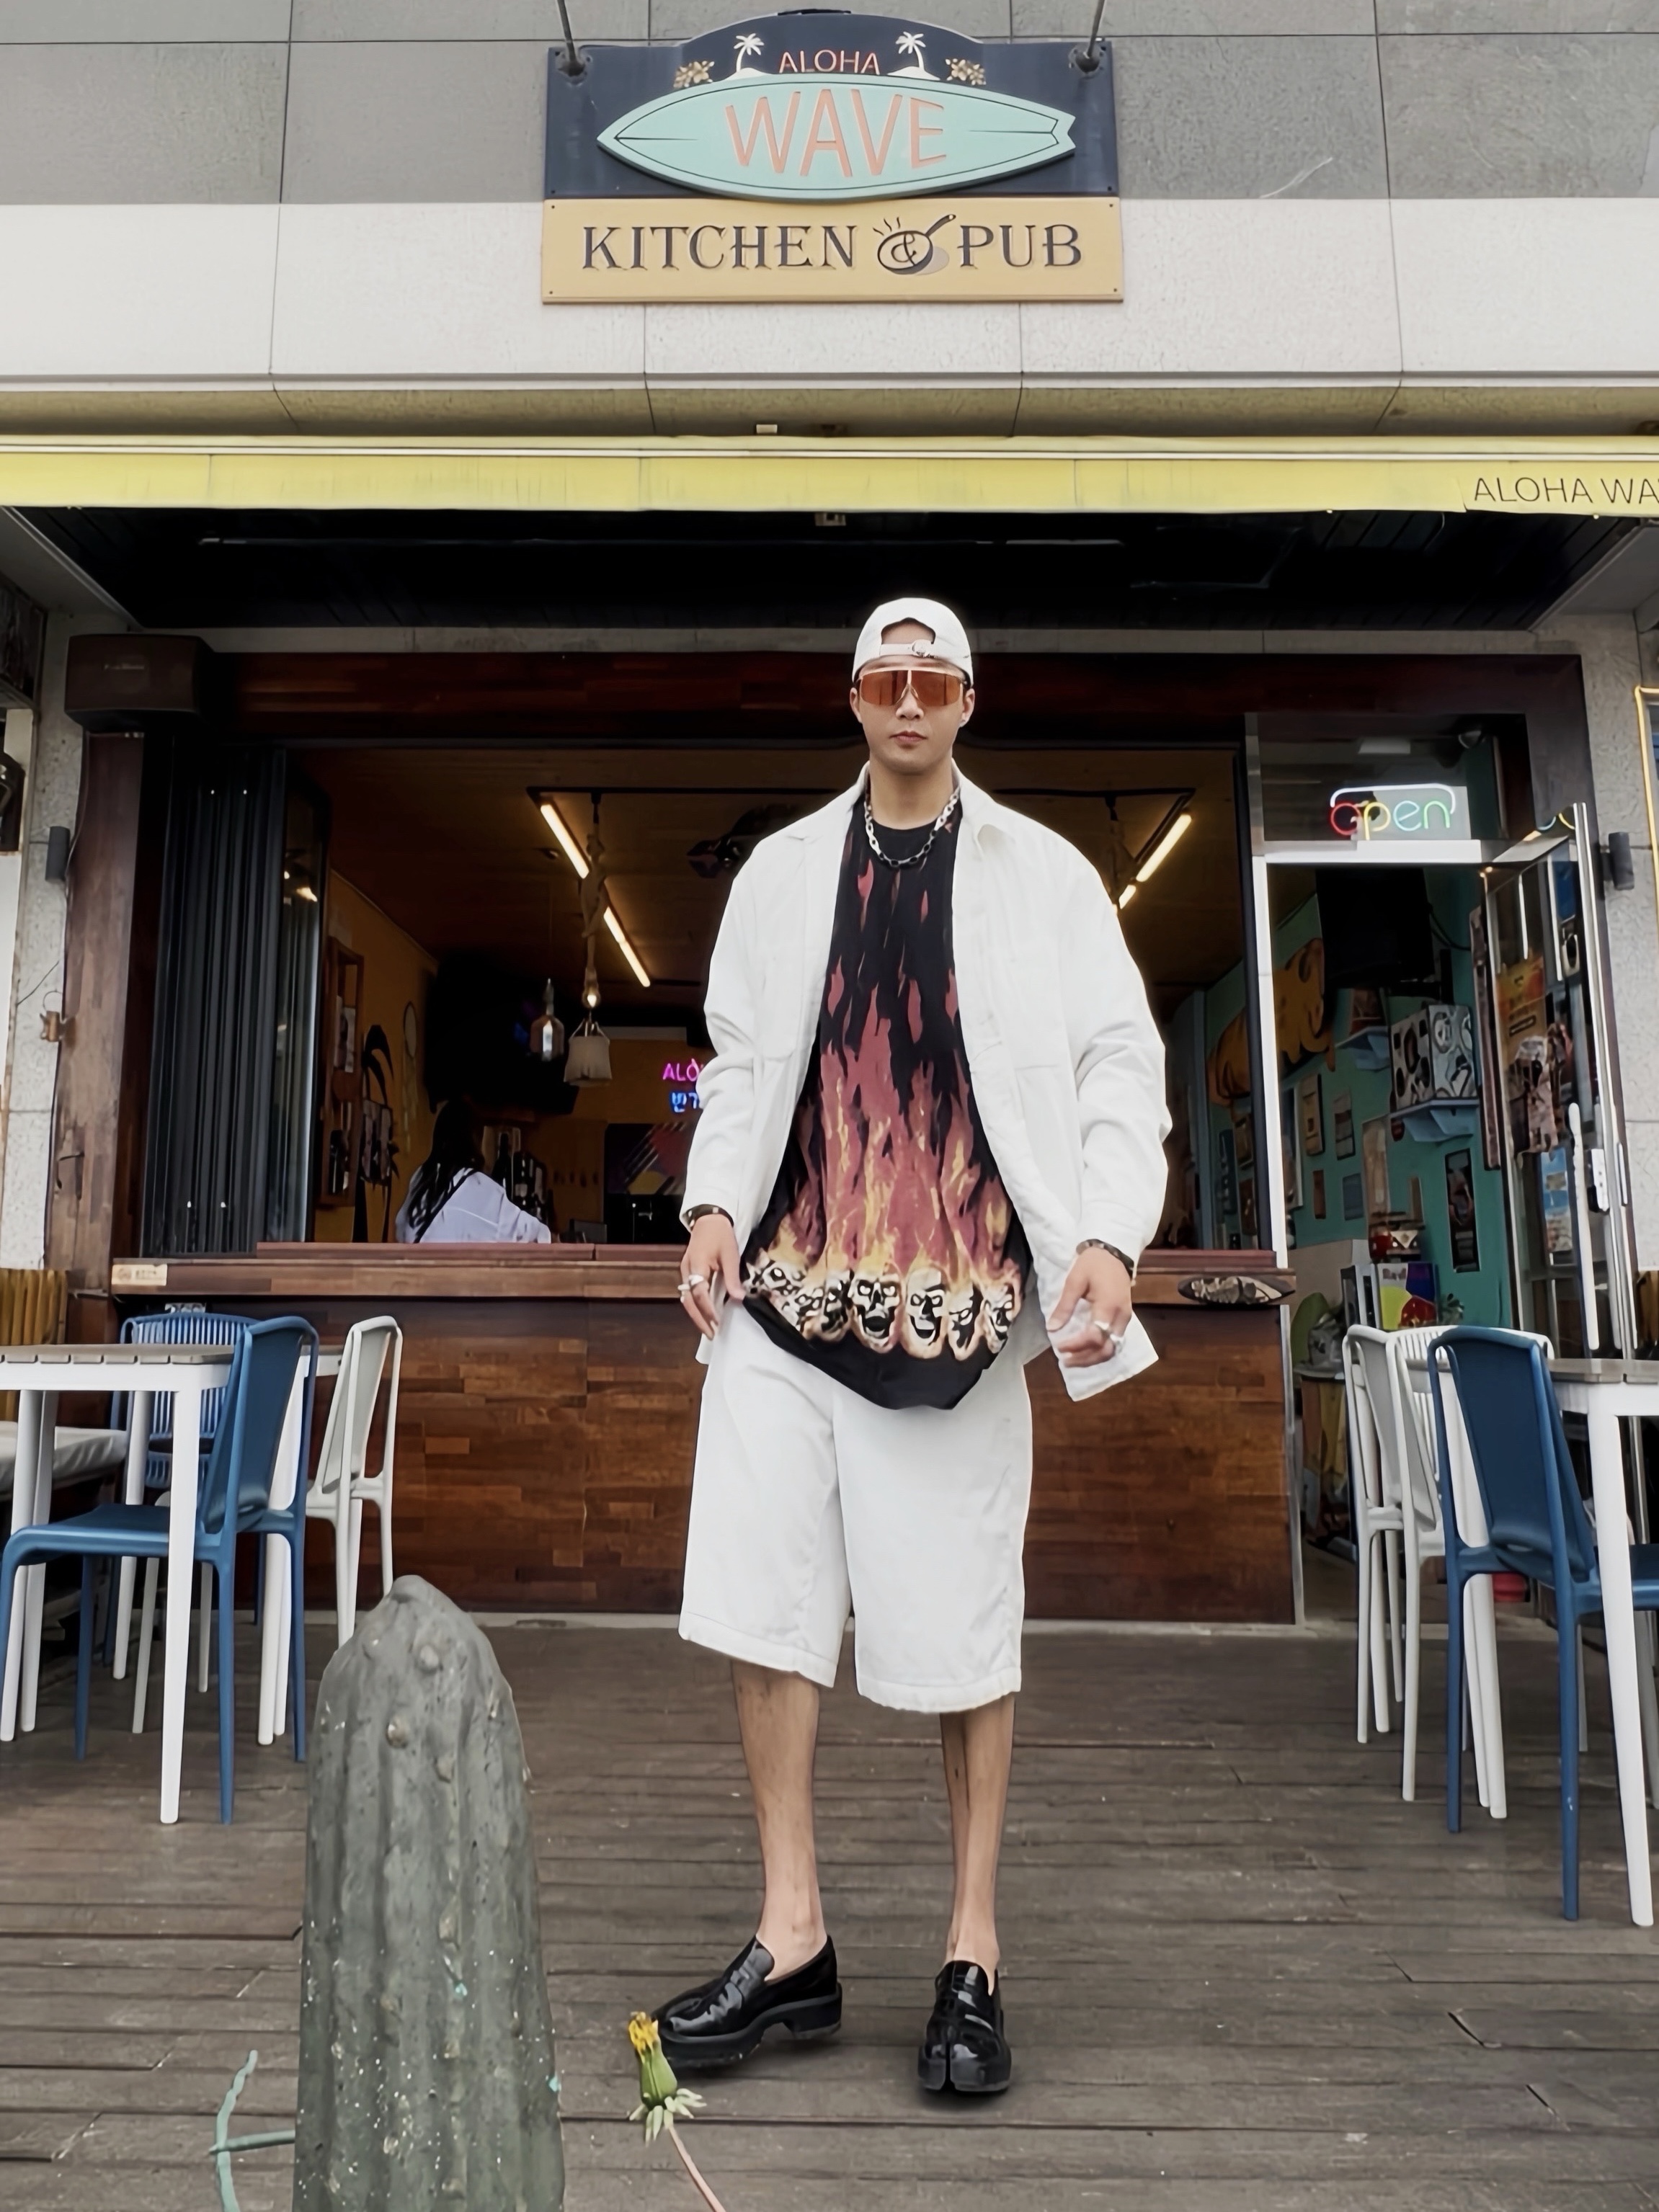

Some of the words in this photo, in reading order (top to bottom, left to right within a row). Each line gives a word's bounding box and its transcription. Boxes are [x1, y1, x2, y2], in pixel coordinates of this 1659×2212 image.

[778, 50, 880, 74] ALOHA
[726, 88, 947, 178] WAVE
[582, 225, 858, 271] KITCHEN
[956, 223, 1082, 267] PUB
[1474, 477, 1593, 503] ALOHA
[1600, 478, 1659, 504] WA
[662, 1058, 703, 1082] ALO
